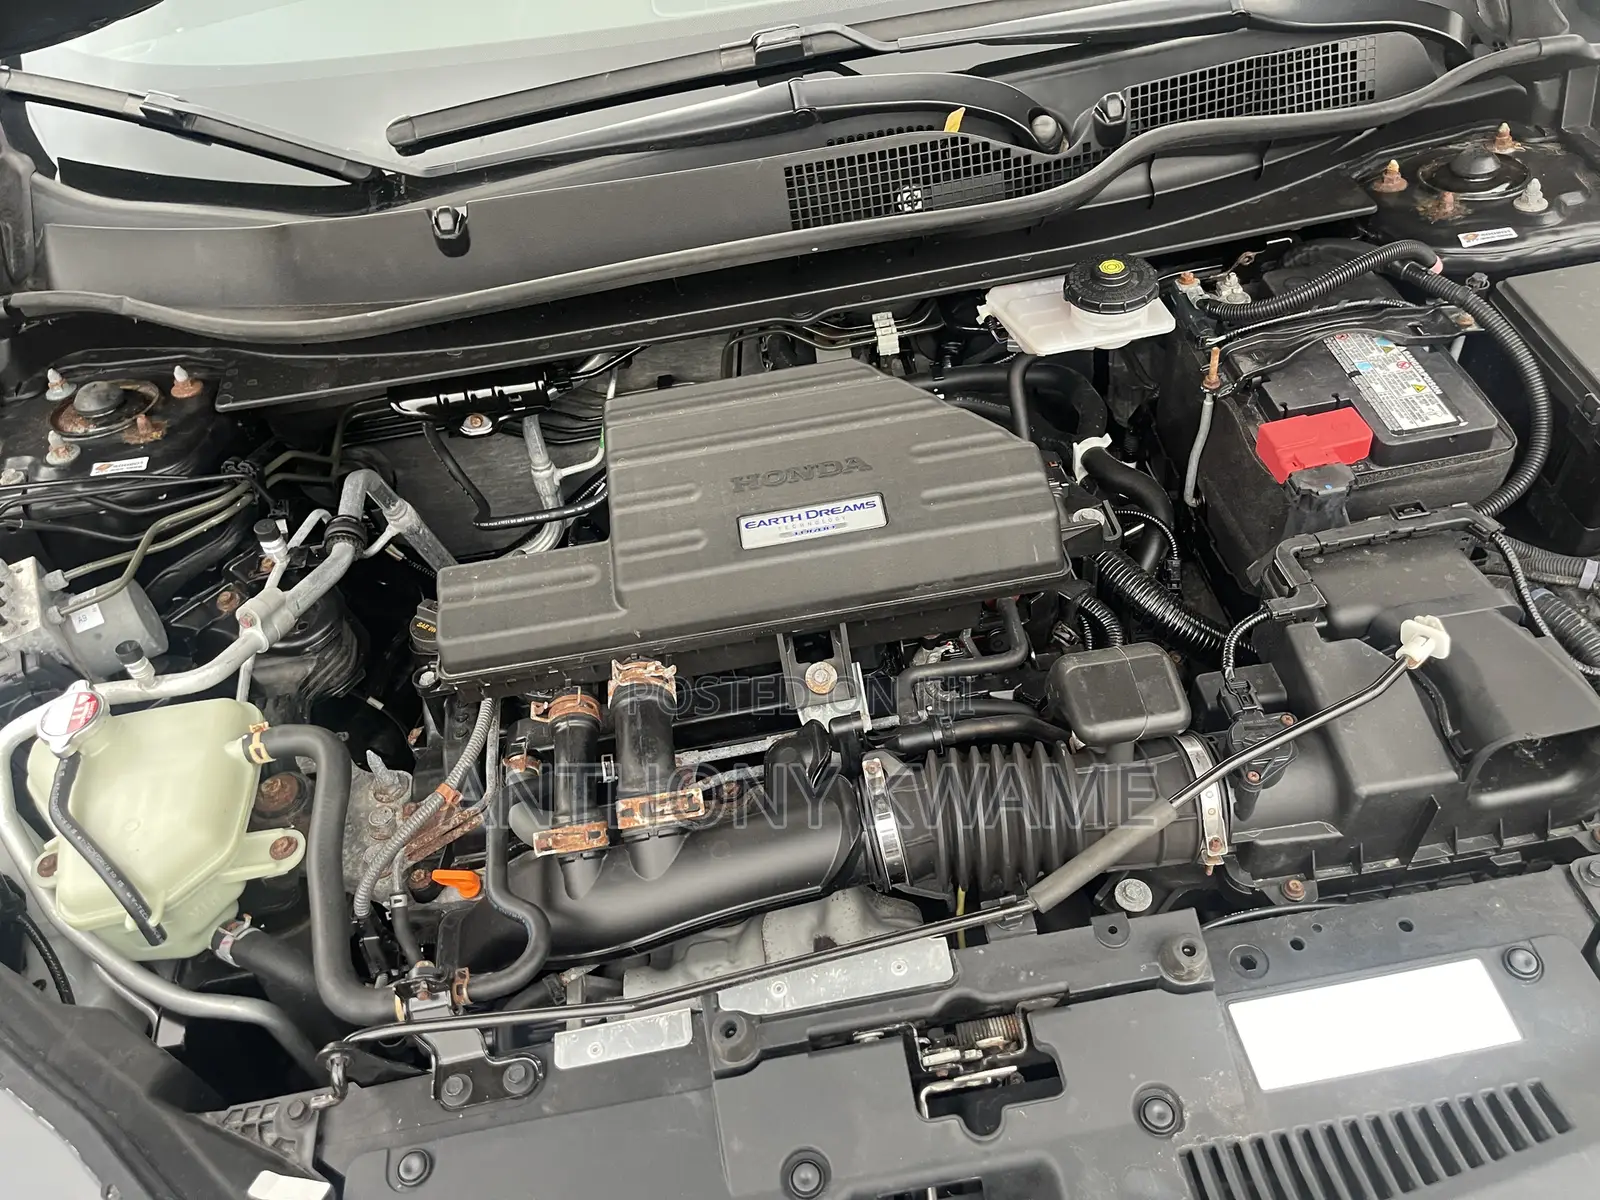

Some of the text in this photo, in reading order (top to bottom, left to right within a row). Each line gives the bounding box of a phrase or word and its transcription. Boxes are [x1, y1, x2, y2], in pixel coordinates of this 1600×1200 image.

[731, 456, 873, 493] HONDA
[744, 513, 802, 530] EARTH
[778, 516, 847, 532] TECHNOLOGY
